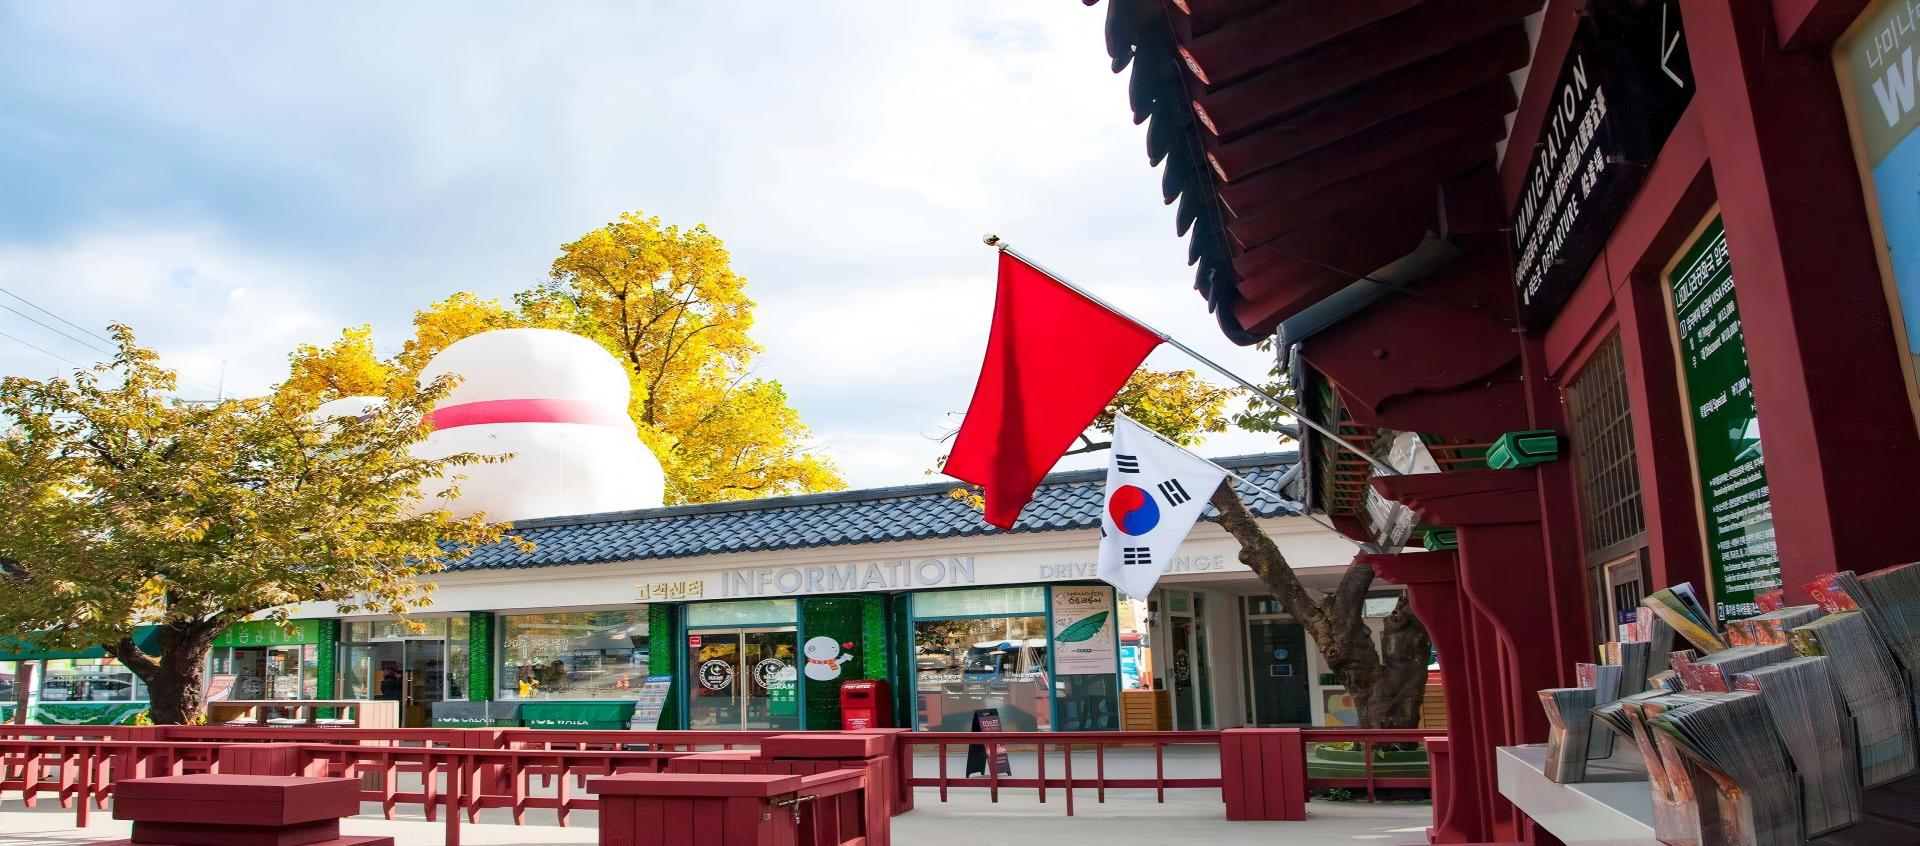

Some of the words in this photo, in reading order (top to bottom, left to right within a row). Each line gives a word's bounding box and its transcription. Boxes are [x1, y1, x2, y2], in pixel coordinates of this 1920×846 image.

[1871, 45, 1920, 128] W
[1515, 54, 1587, 248] IMMIGRATION
[1542, 193, 1579, 274] DEPARTURE
[633, 581, 704, 601] 고객센터
[720, 556, 975, 596] INFORMATION
